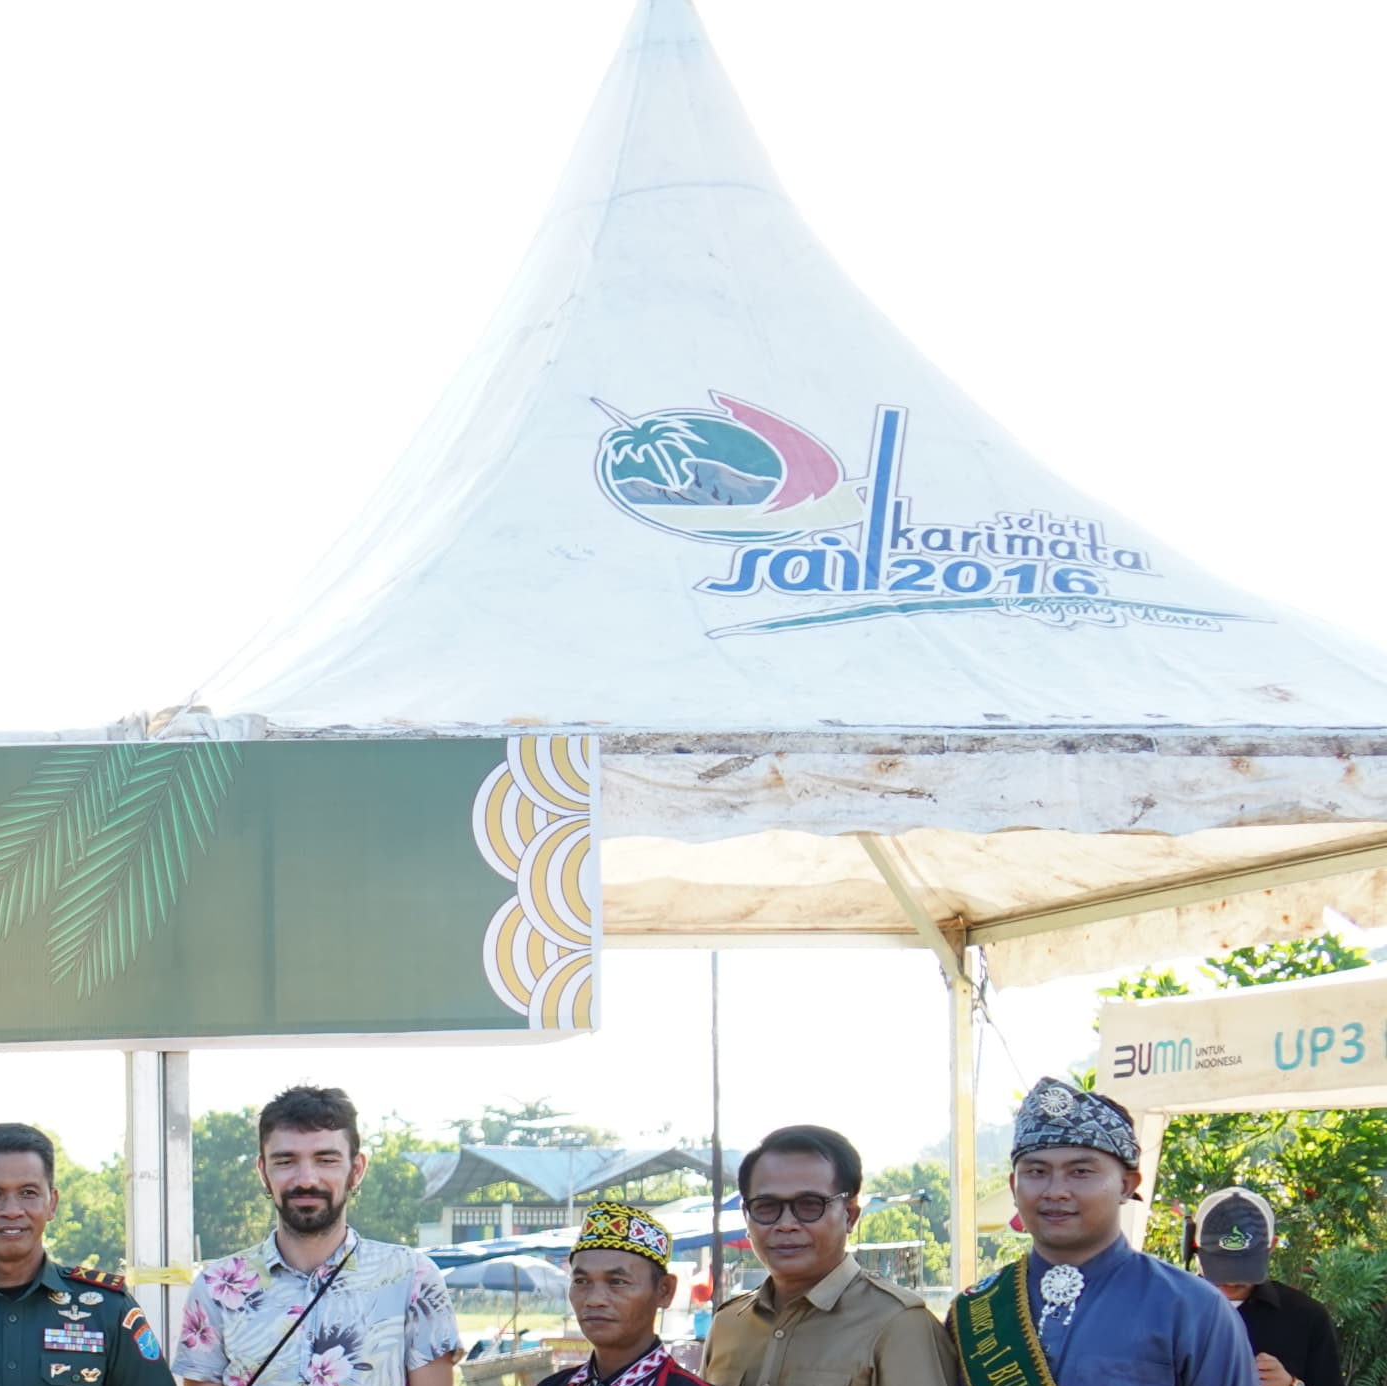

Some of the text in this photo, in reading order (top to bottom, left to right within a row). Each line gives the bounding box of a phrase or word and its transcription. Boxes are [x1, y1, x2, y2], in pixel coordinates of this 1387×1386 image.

[890, 500, 1146, 570] karimata
[888, 558, 1100, 595] 2016
[1195, 1045, 1226, 1057] UNTUK
[1195, 1055, 1242, 1069] INDONESIA
[1274, 1021, 1366, 1071] UP3
